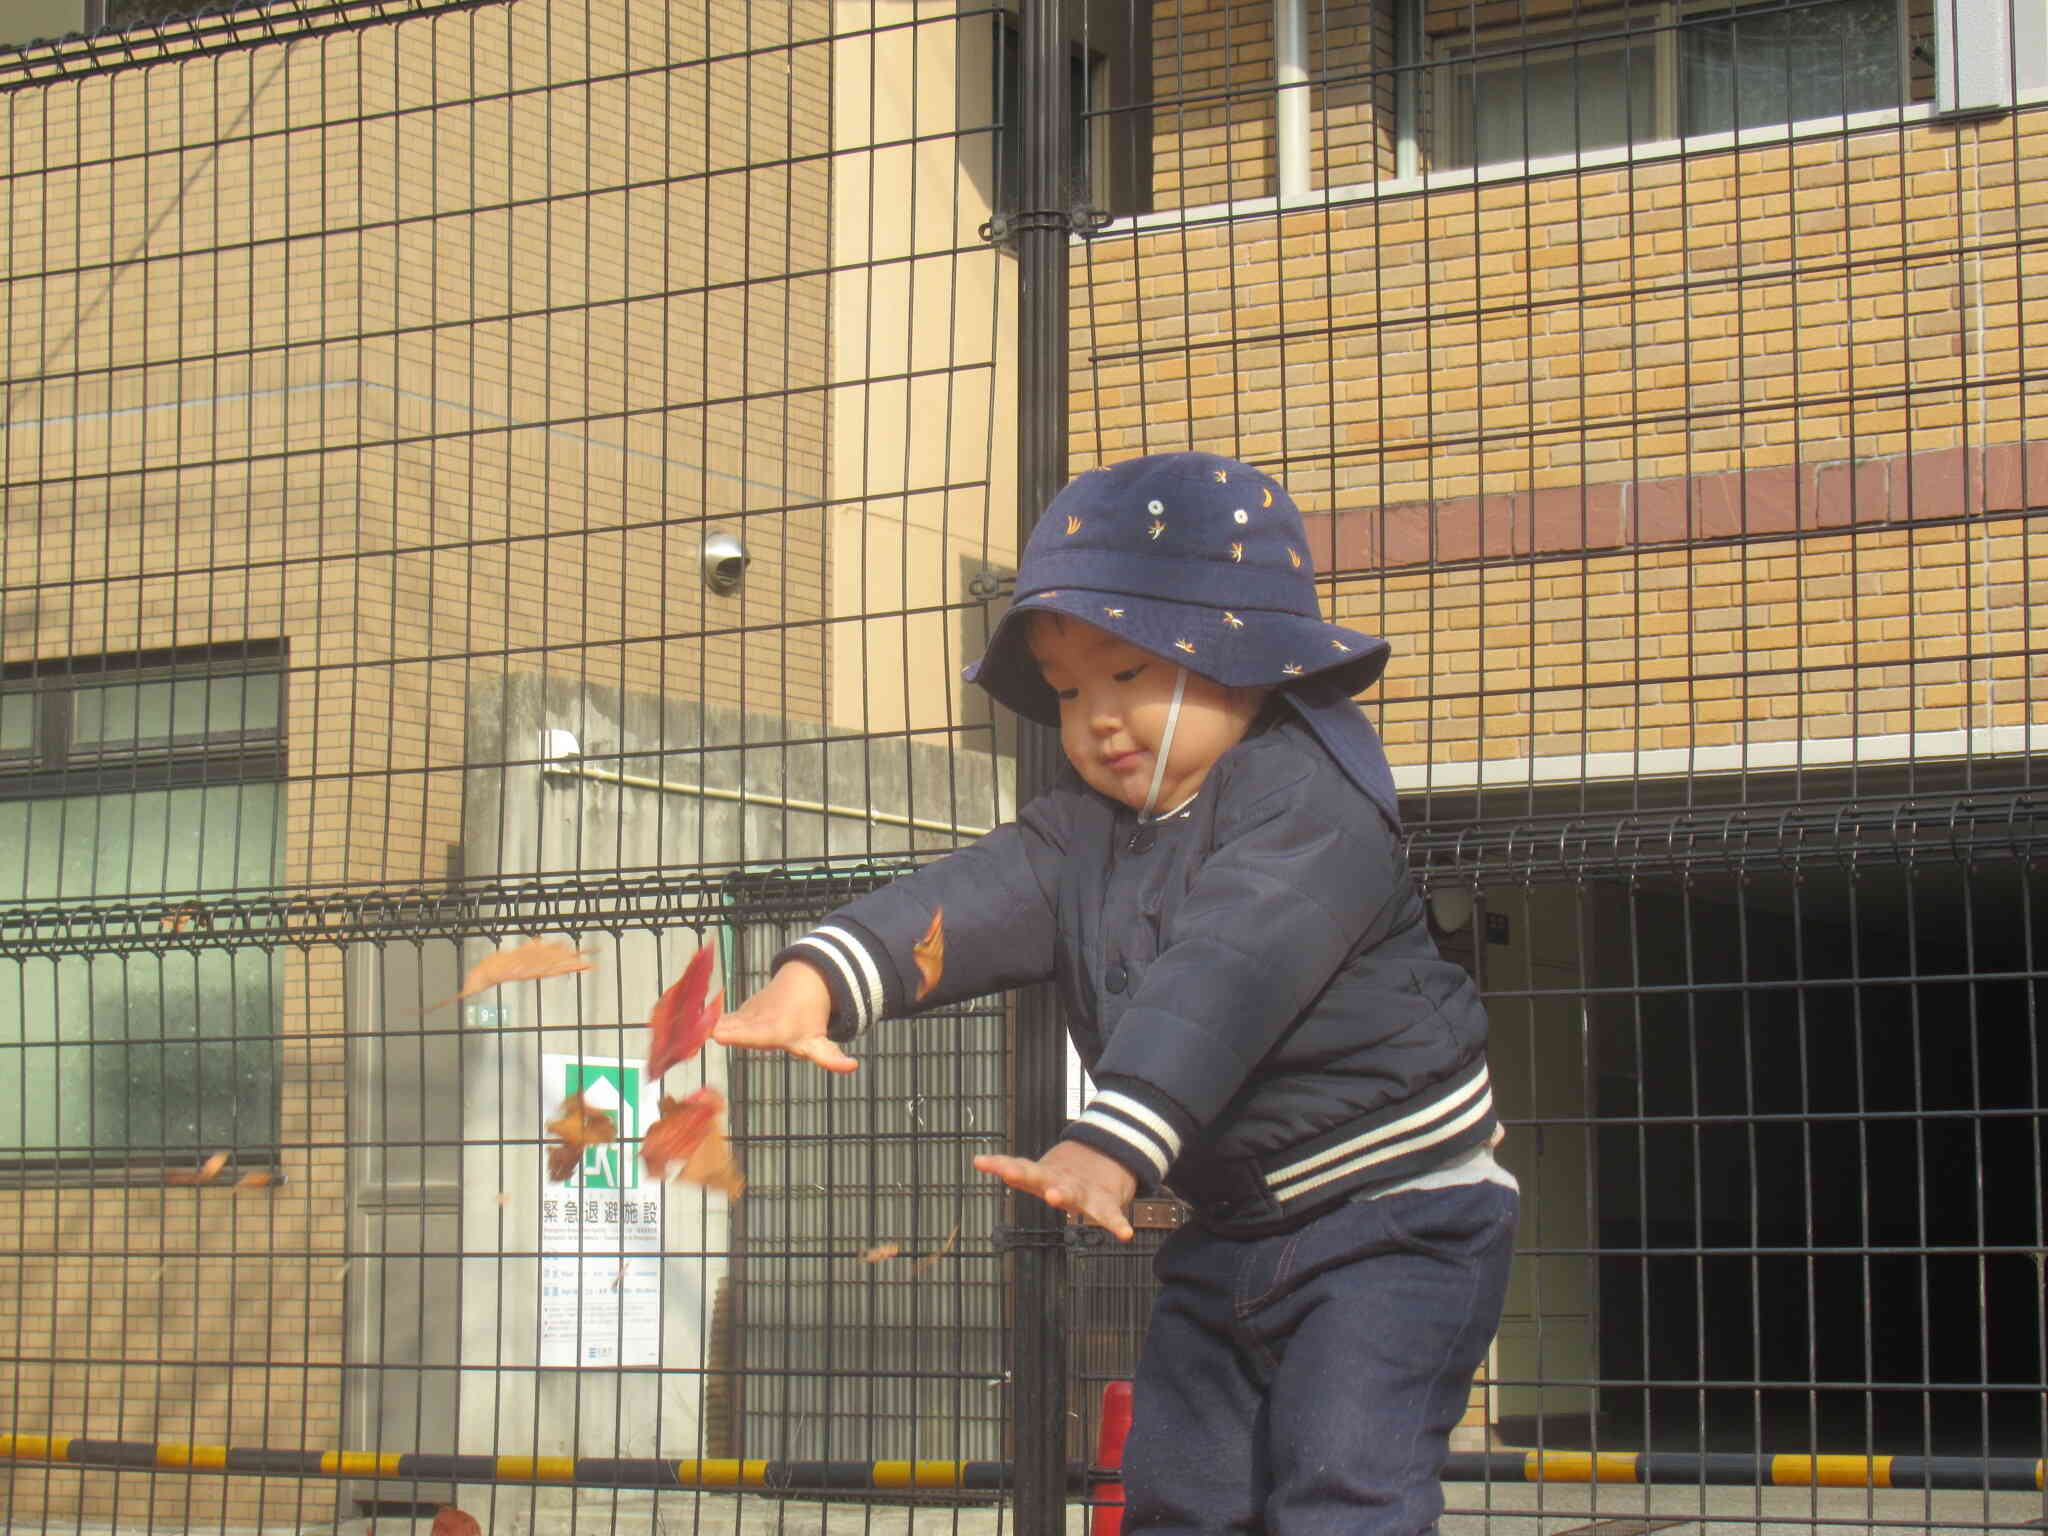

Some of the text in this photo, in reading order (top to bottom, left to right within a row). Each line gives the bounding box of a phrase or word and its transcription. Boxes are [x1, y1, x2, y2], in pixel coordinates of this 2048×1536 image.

[543, 1200, 657, 1224] 緊急退避施設
